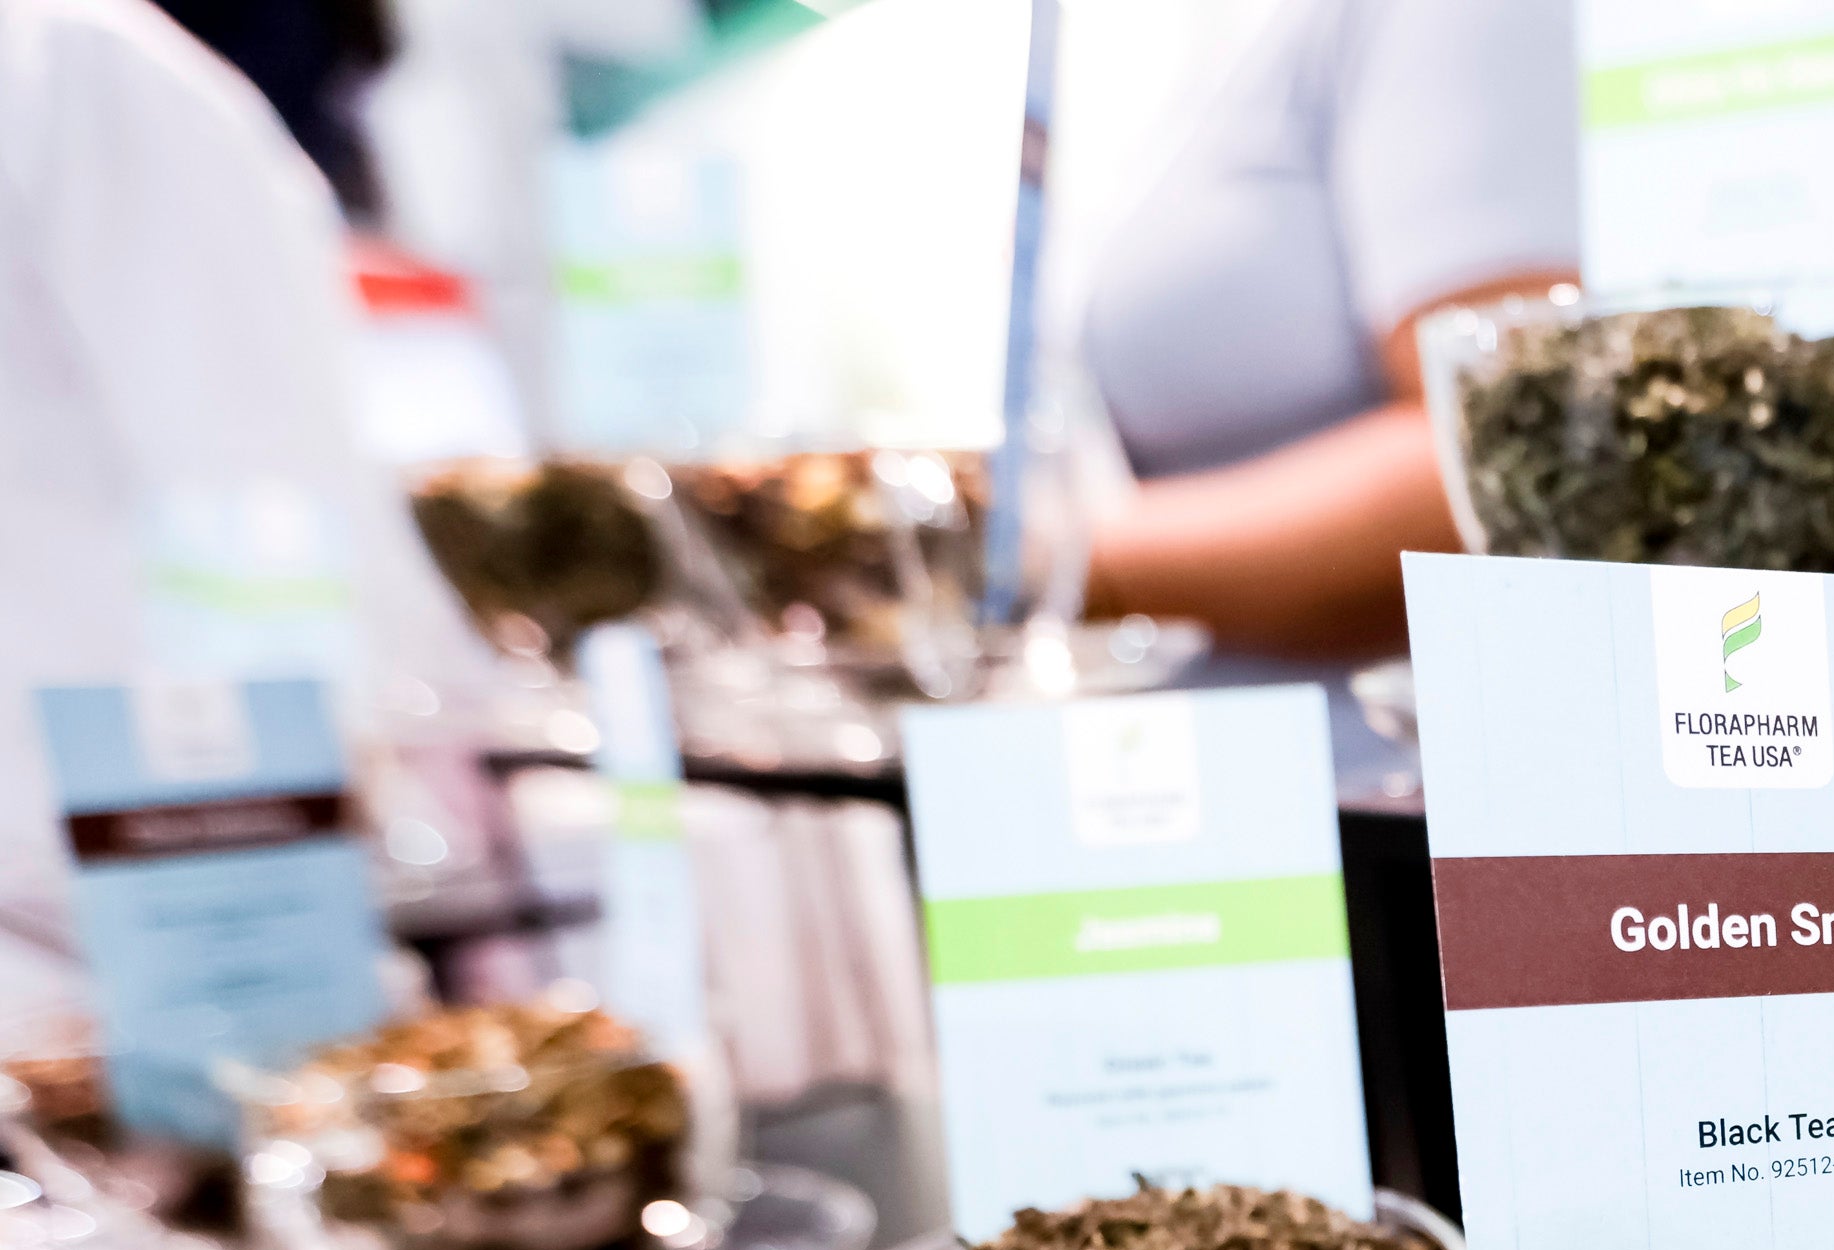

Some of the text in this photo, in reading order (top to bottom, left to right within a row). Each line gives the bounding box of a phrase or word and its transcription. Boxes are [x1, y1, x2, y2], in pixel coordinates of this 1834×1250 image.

[1674, 712, 1819, 737] FLORAPHARM
[1705, 744, 1747, 767] TEA
[1610, 902, 1778, 952] Golden
[1698, 1114, 1782, 1149] Black
[1679, 1168, 1725, 1188] Item
[1731, 1163, 1765, 1183] No.
